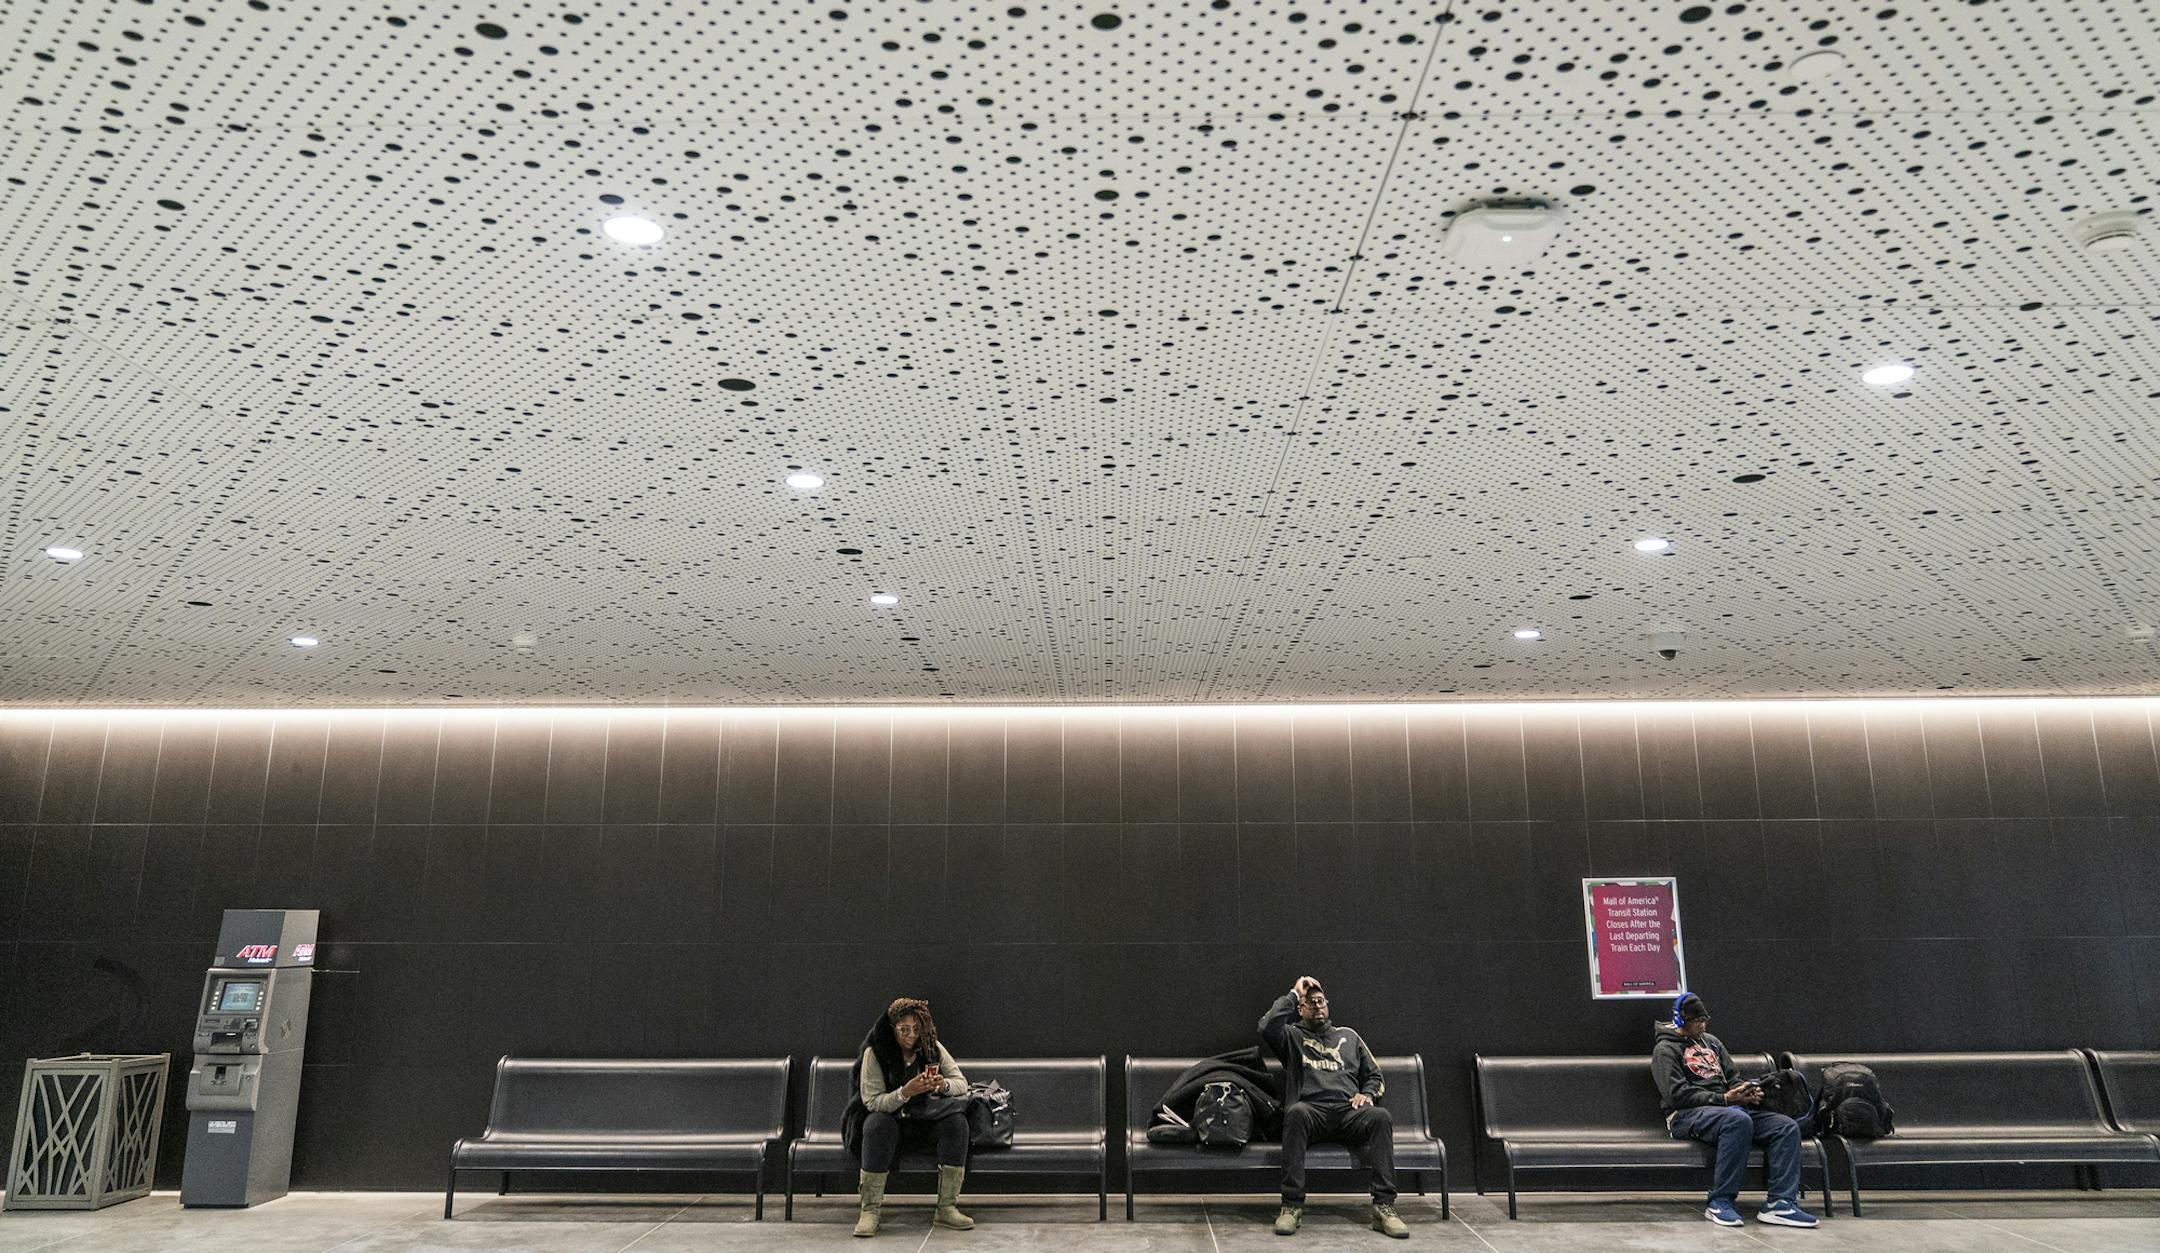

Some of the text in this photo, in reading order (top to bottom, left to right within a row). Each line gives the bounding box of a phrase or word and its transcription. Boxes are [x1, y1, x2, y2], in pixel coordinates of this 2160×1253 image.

[1603, 897, 1617, 905] Mall
[1618, 896, 1626, 905] of
[1608, 908, 1658, 916] Transit Station
[1606, 920, 1661, 928] Closes After the
[1609, 931, 1660, 941] Last Departing
[236, 945, 277, 958] ATM
[1610, 943, 1661, 953] Train Each Day
